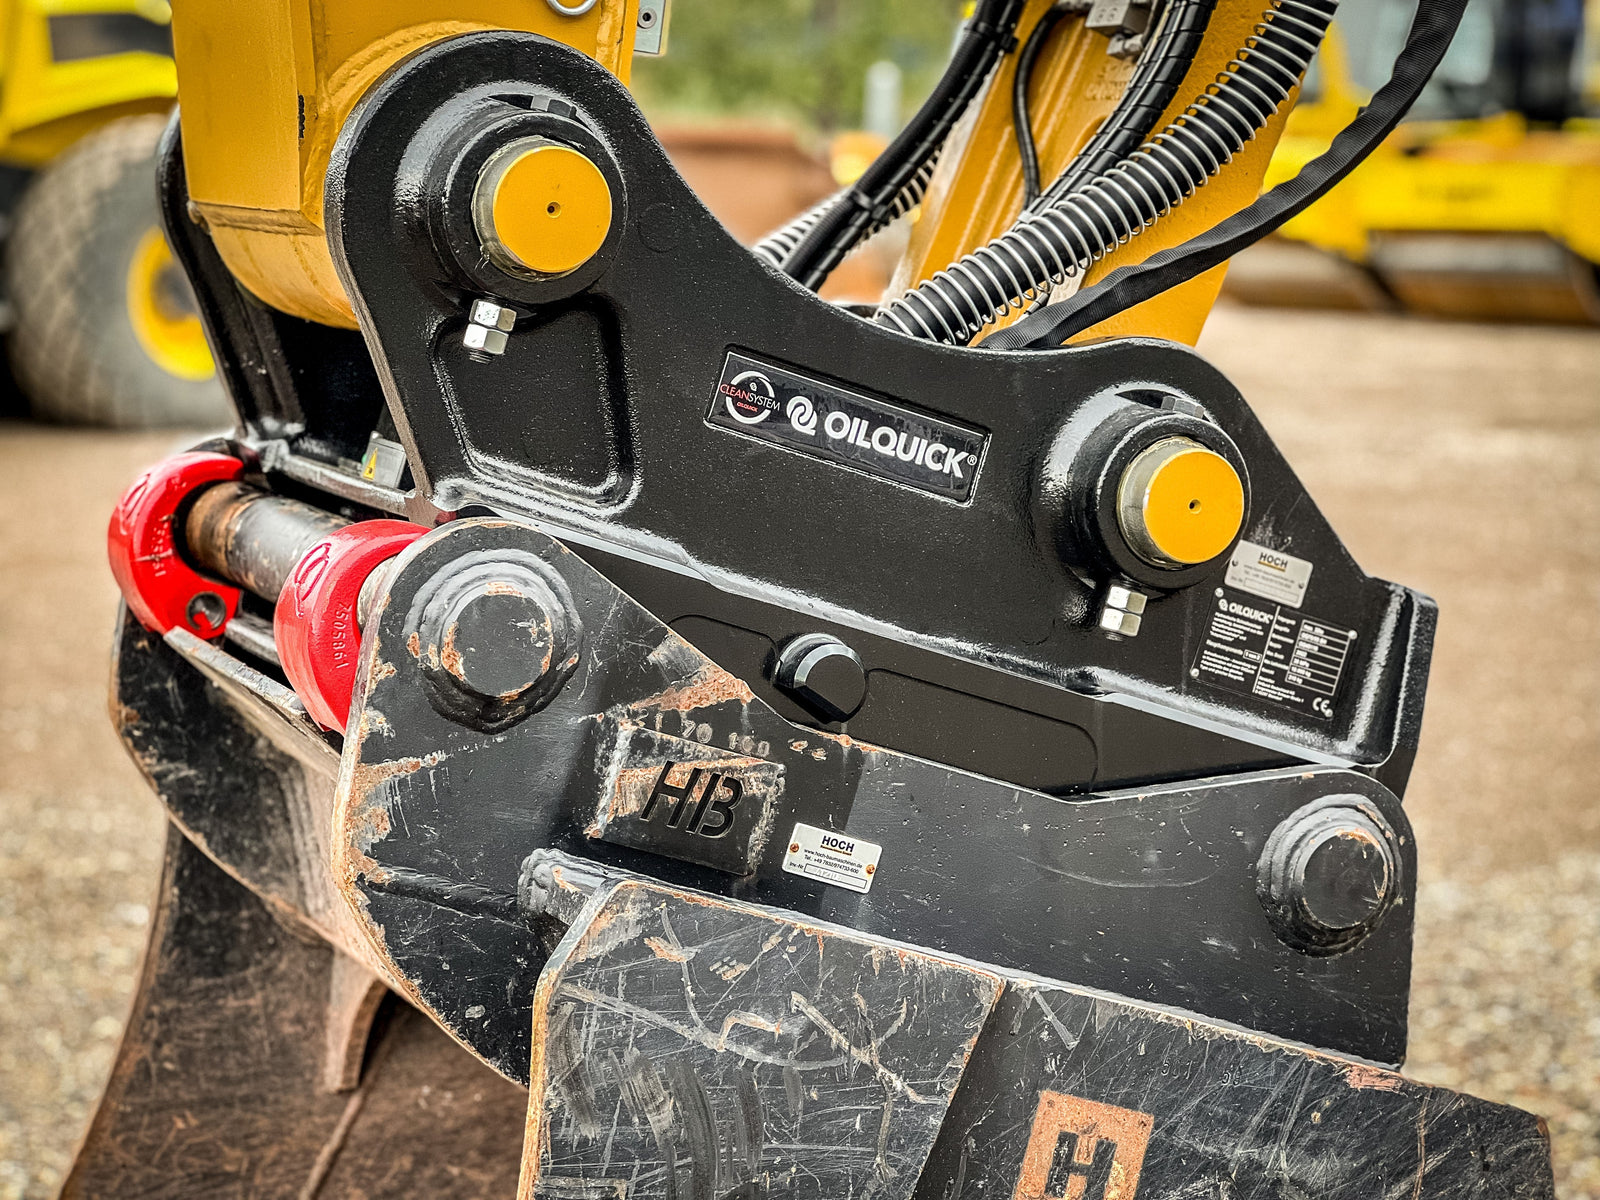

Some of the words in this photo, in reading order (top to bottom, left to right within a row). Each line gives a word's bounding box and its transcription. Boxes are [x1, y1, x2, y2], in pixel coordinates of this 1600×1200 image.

[1259, 552, 1288, 568] HOCH
[639, 760, 744, 839] HB
[821, 835, 855, 853] HOCH
